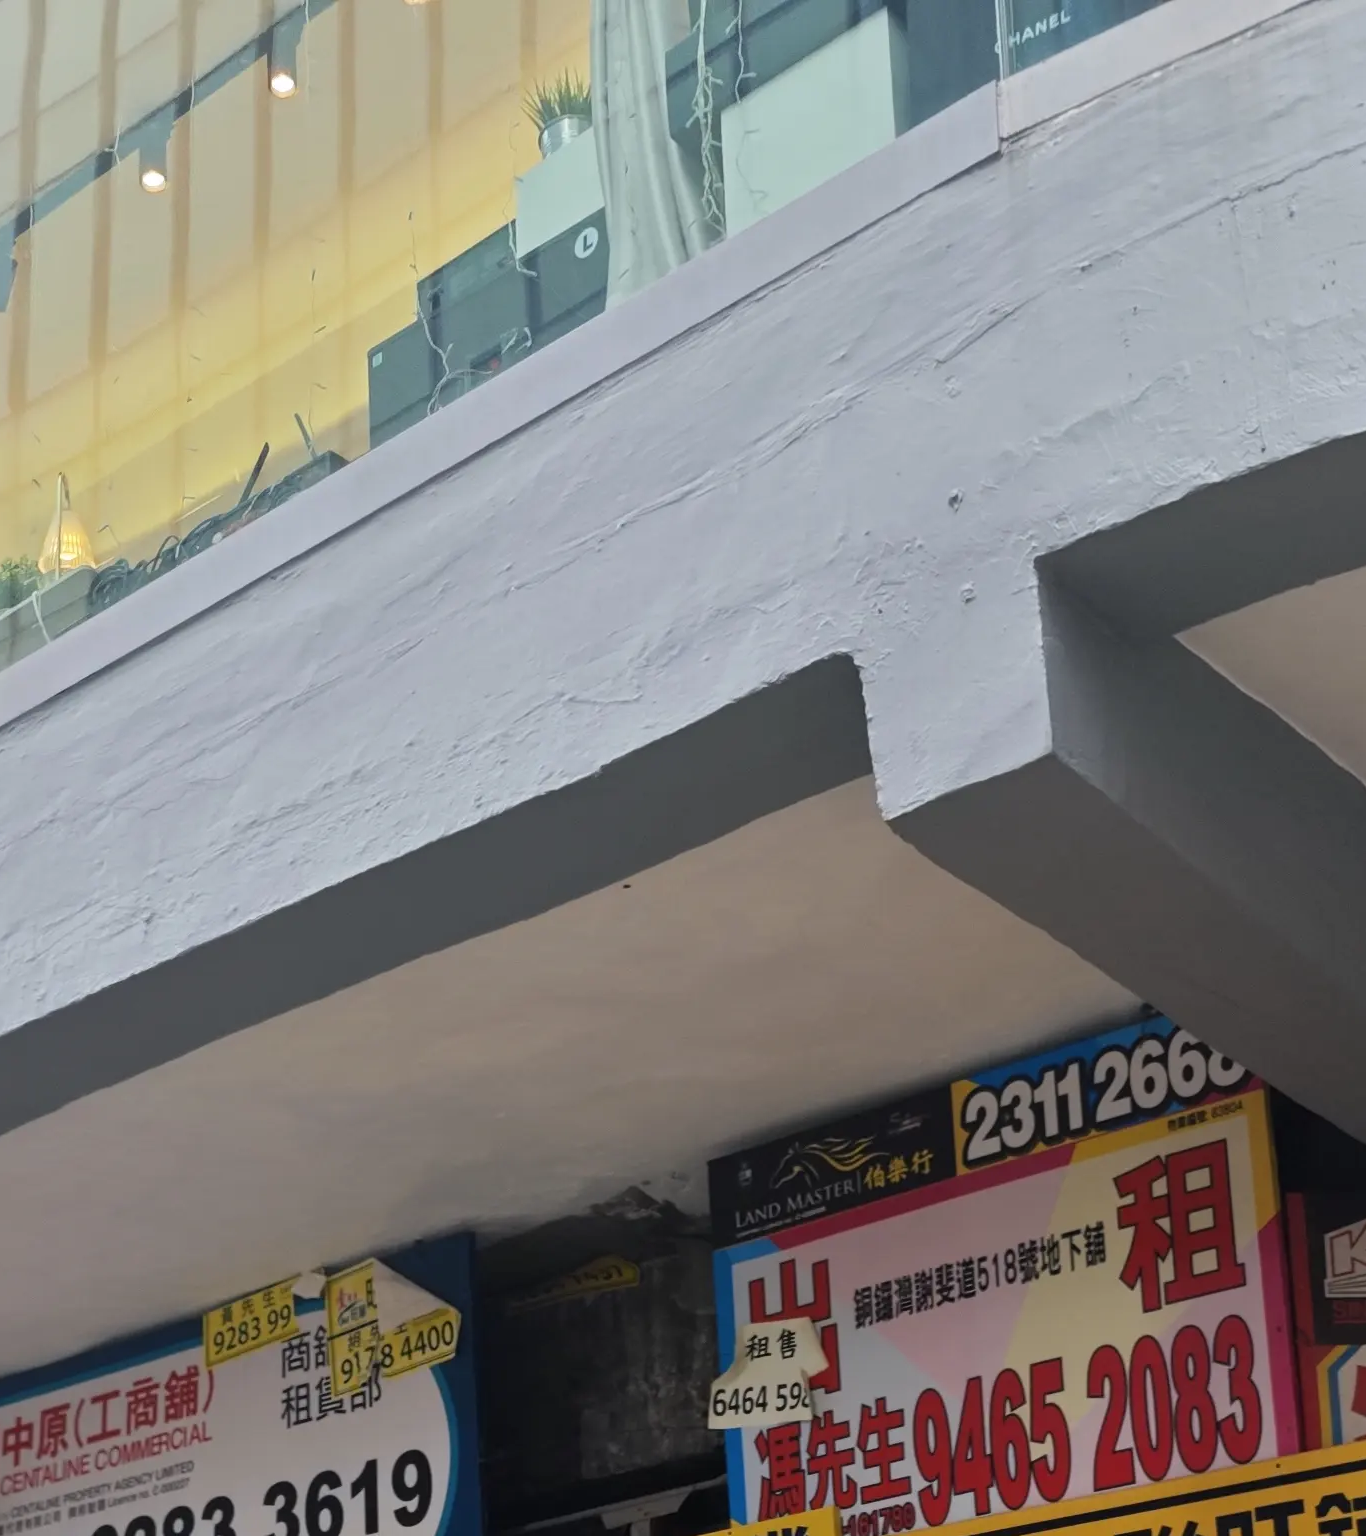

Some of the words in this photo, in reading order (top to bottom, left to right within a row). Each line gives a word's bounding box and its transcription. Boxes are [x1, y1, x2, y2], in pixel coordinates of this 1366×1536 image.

[963, 1060, 1085, 1163] 2311
[863, 1149, 934, 1190] 伯樂行
[736, 1201, 782, 1229] LAND
[786, 1178, 855, 1213] MASTER
[1111, 1136, 1246, 1315] 租
[212, 1317, 262, 1356] 9283
[399, 1320, 455, 1360] 4400
[712, 1384, 768, 1417] 6464
[753, 1396, 913, 1523] 馮先生
[912, 1356, 1073, 1527] 9465
[1086, 1314, 1263, 1493] 2083
[0, 1453, 91, 1497] CENTALINE
[94, 1421, 214, 1472] COMMERCIAL
